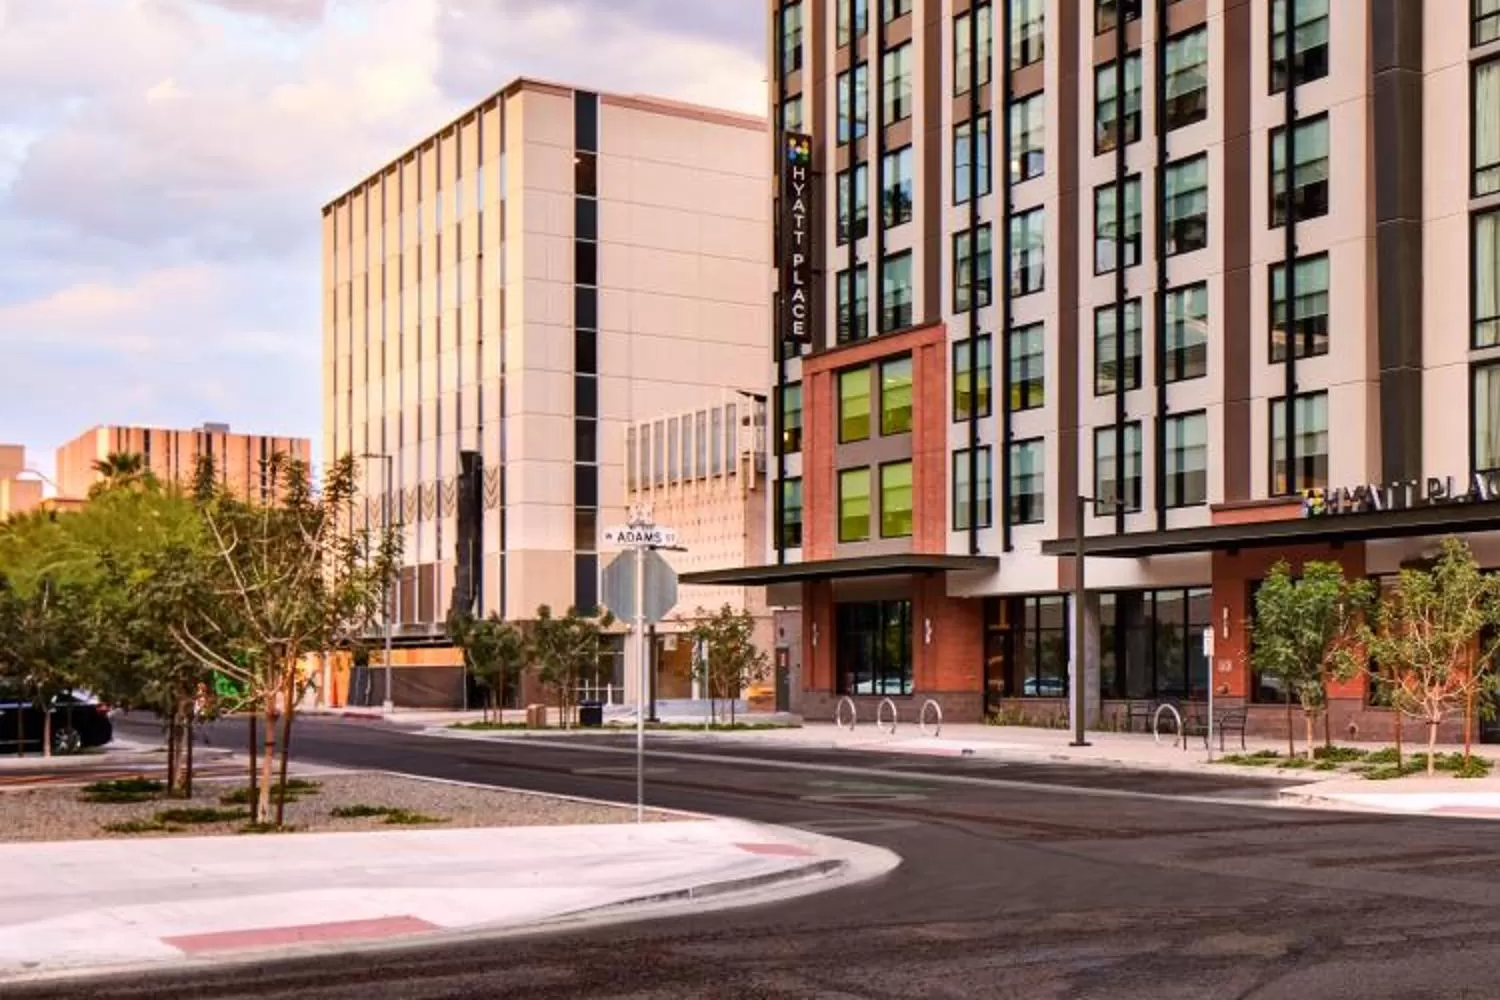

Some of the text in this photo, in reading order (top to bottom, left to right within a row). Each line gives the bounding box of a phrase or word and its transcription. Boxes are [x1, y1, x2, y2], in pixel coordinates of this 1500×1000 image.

[791, 166, 806, 336] HYATT PLACE
[1324, 477, 1418, 515] HYATT
[617, 530, 662, 543] ADAMS
